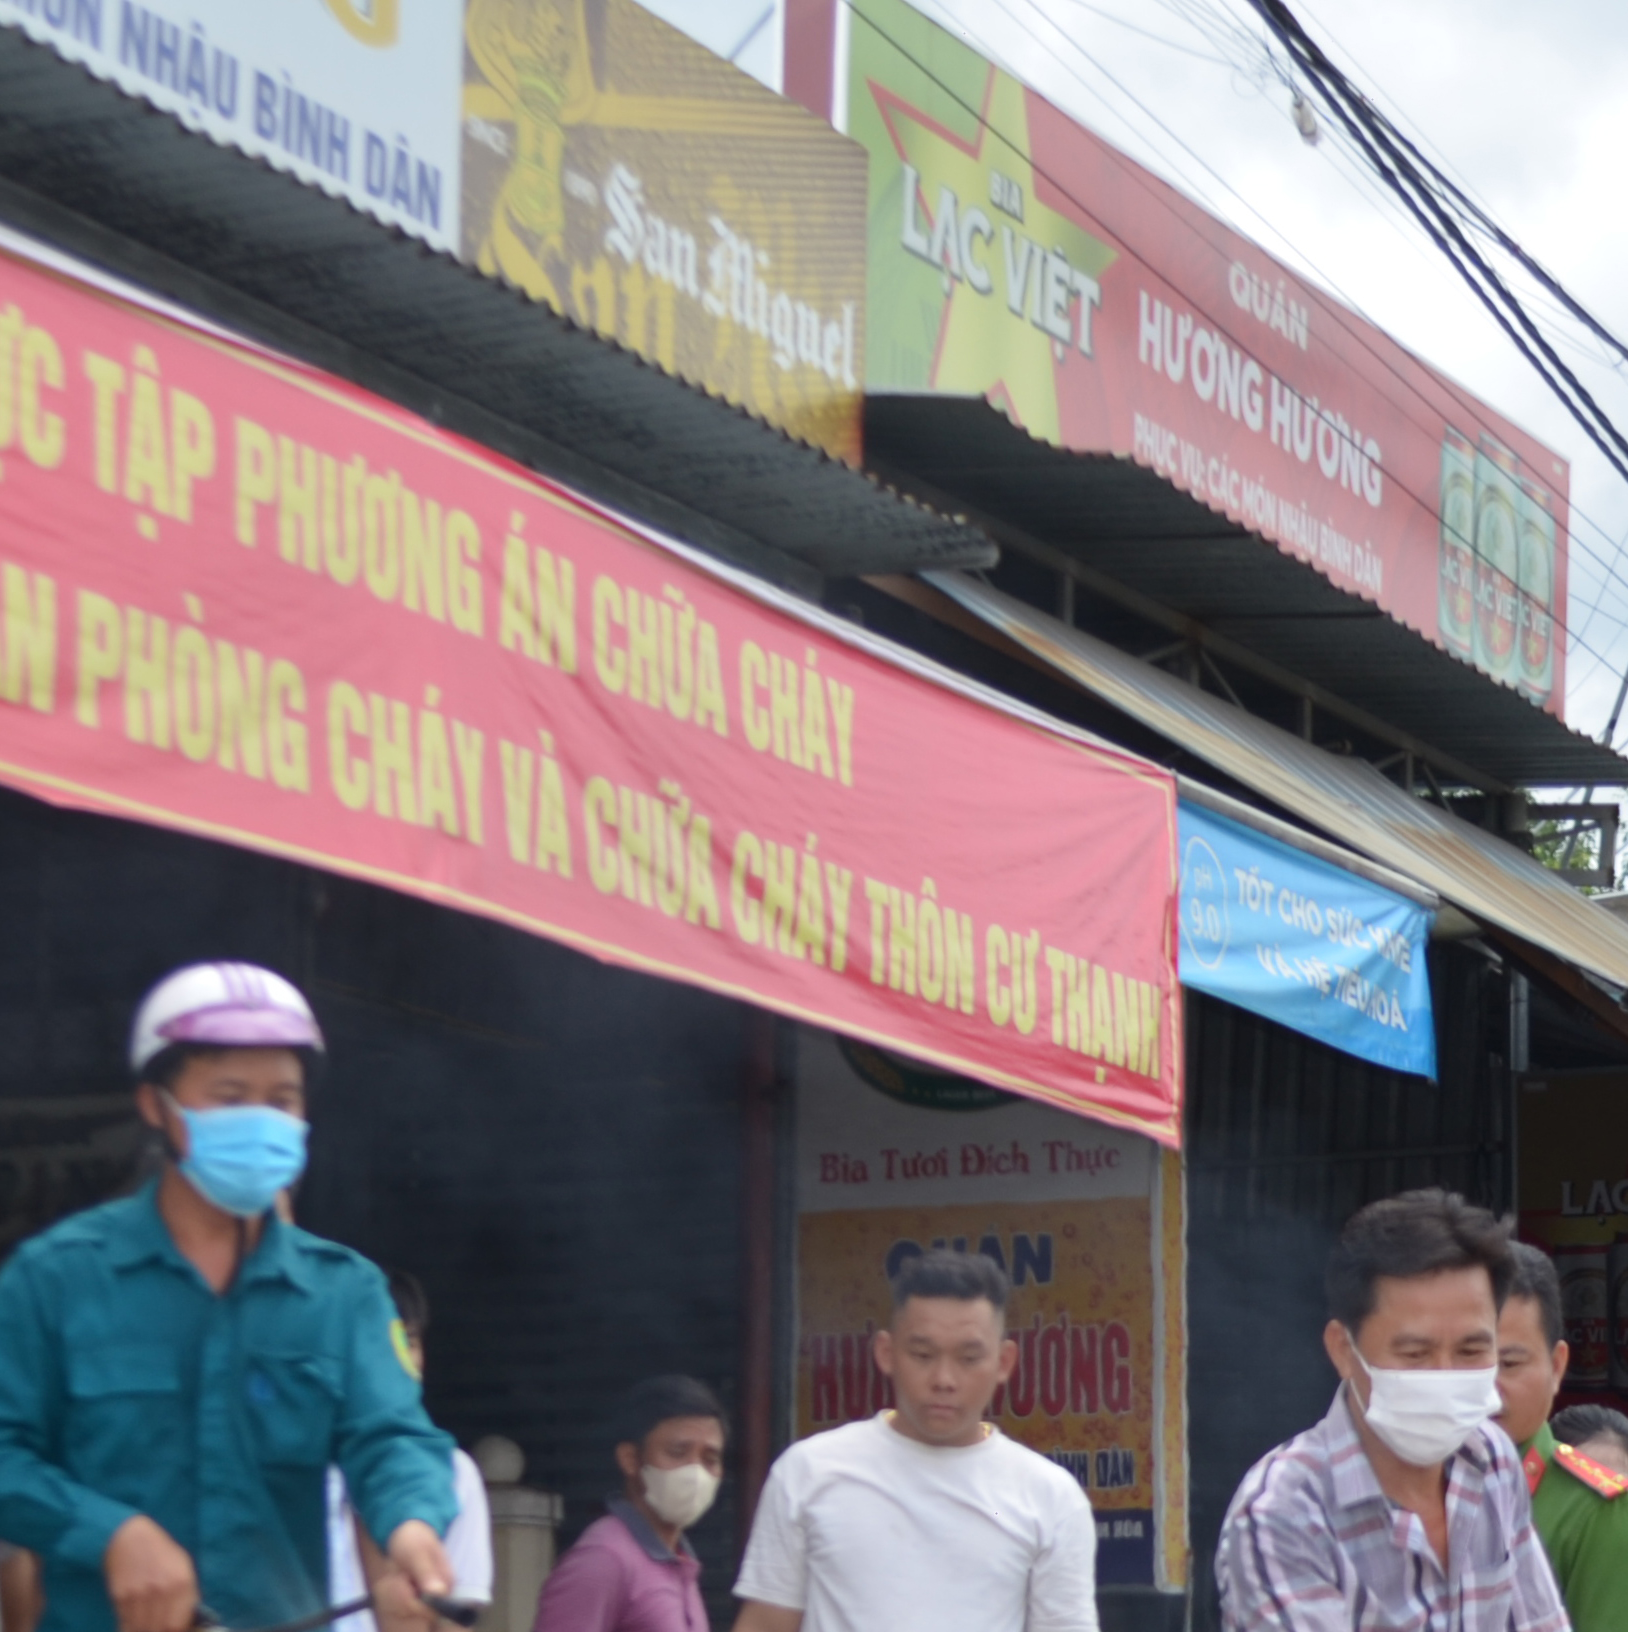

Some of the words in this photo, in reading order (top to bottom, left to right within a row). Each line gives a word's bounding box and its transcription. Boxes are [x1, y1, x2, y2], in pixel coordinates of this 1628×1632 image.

[120, 0, 238, 121] NHẬU
[253, 67, 352, 183] BÌNH
[363, 132, 443, 232] DÂN
[603, 161, 702, 298] San
[701, 213, 858, 392] Miguel
[900, 161, 995, 300] LẠC
[1000, 221, 1103, 365] VIỆT
[1229, 261, 1309, 351] QUÁN
[1138, 288, 1264, 433] HƯƠNG
[1270, 373, 1382, 508] HƯƠNG
[83, 344, 217, 542] TẬP
[235, 416, 482, 637] PHƯƠNG
[498, 511, 576, 675] ÁN
[591, 573, 729, 737] CHỮA
[739, 640, 855, 788] CHÁY
[1207, 453, 1240, 510] CÁC
[1354, 540, 1382, 595] DÂN
[74, 592, 310, 794] PHÒNG
[327, 681, 486, 848] CHÁY
[498, 729, 572, 879] VÀ
[582, 774, 721, 932] CHỮA
[731, 830, 852, 973] CHÁY
[863, 875, 975, 1017] THÔN
[984, 922, 1041, 1034] CƯ
[1044, 946, 1163, 1084] THẠNH
[1190, 897, 1221, 943] 9.0
[1233, 866, 1274, 918] TỐT
[1277, 887, 1323, 936] CHO
[819, 1152, 869, 1185] Bia
[880, 1148, 949, 1181] Tươi
[959, 1143, 1030, 1177] Đích
[1041, 1139, 1122, 1177] Thực
[1095, 1444, 1135, 1488] DÂN
